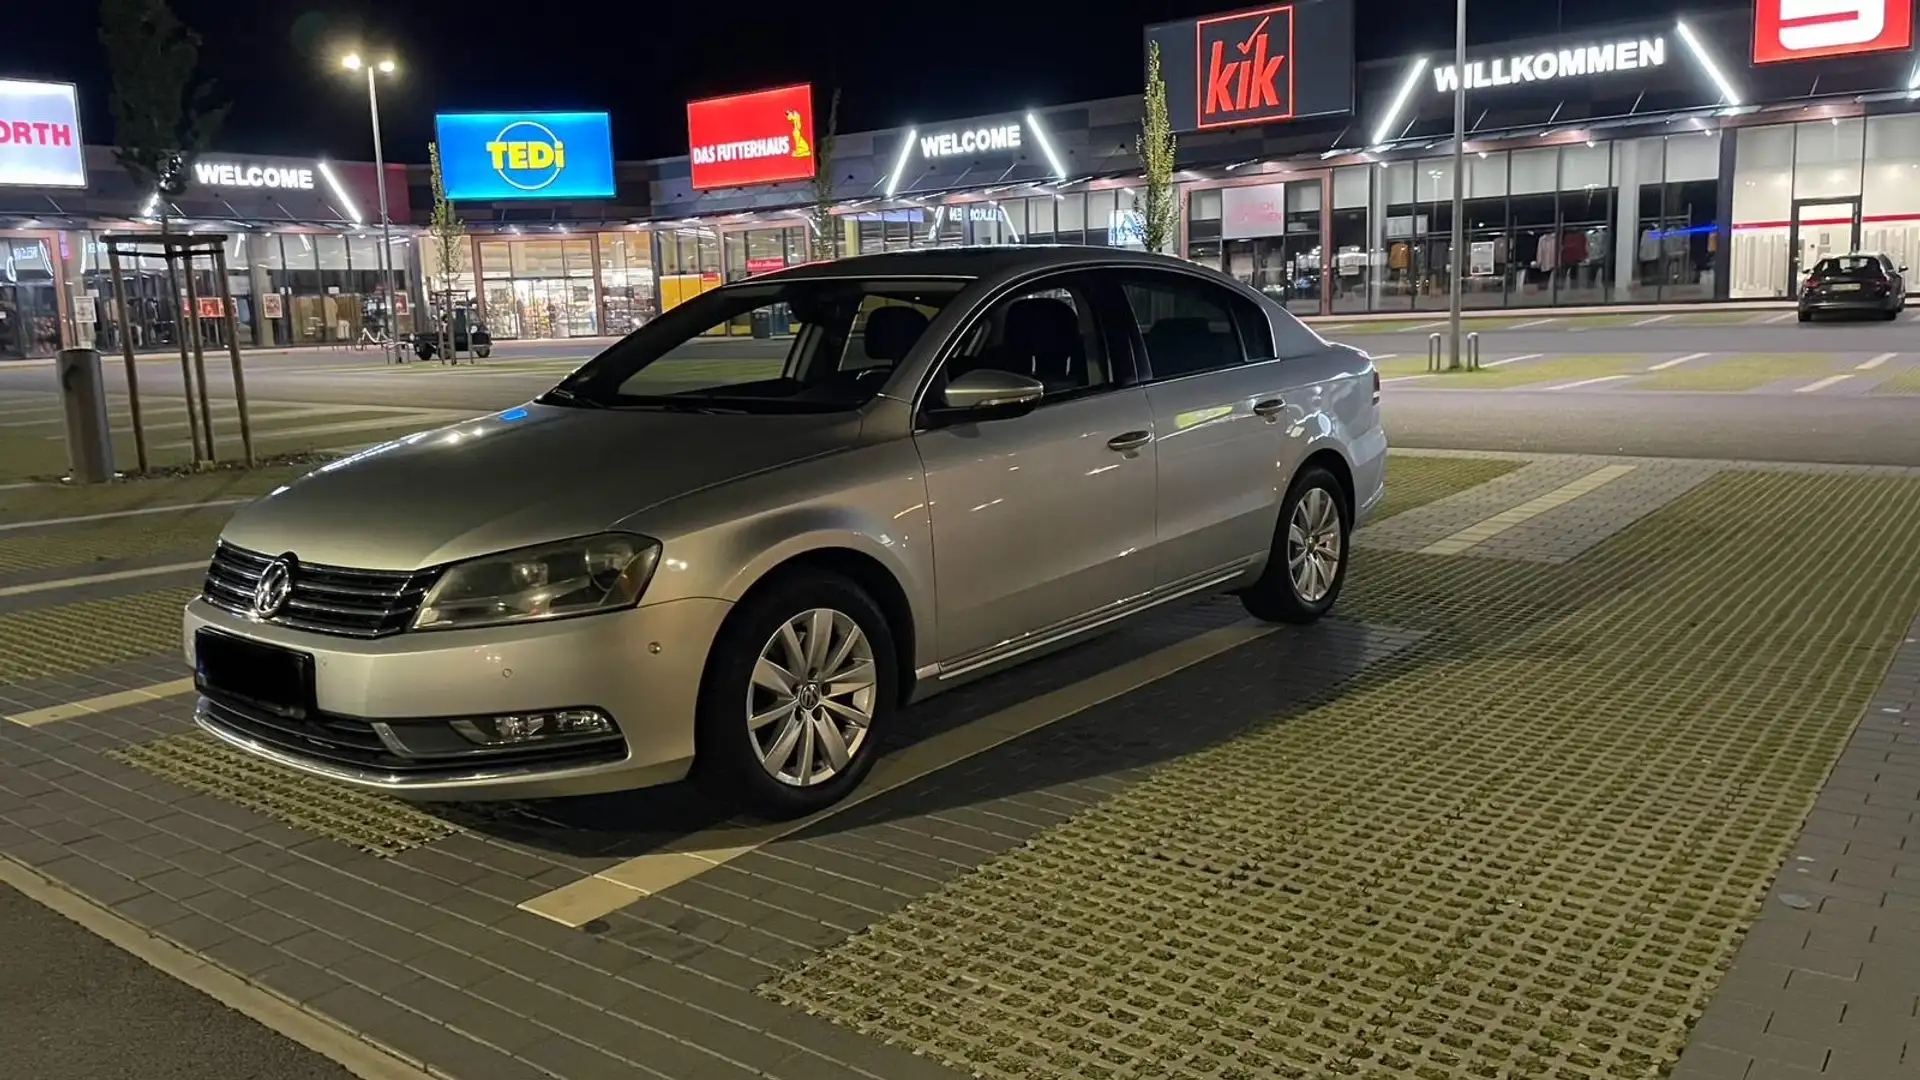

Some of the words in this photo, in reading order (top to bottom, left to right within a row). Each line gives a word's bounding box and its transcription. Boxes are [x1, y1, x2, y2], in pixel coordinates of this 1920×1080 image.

[1434, 37, 1664, 92] WILLKOMMEN
[486, 141, 565, 170] TEDi
[693, 146, 716, 164] DAS
[717, 136, 790, 162] FUTTERHAUS
[920, 124, 1021, 158] WELCOME
[195, 163, 314, 189] WELCOME
